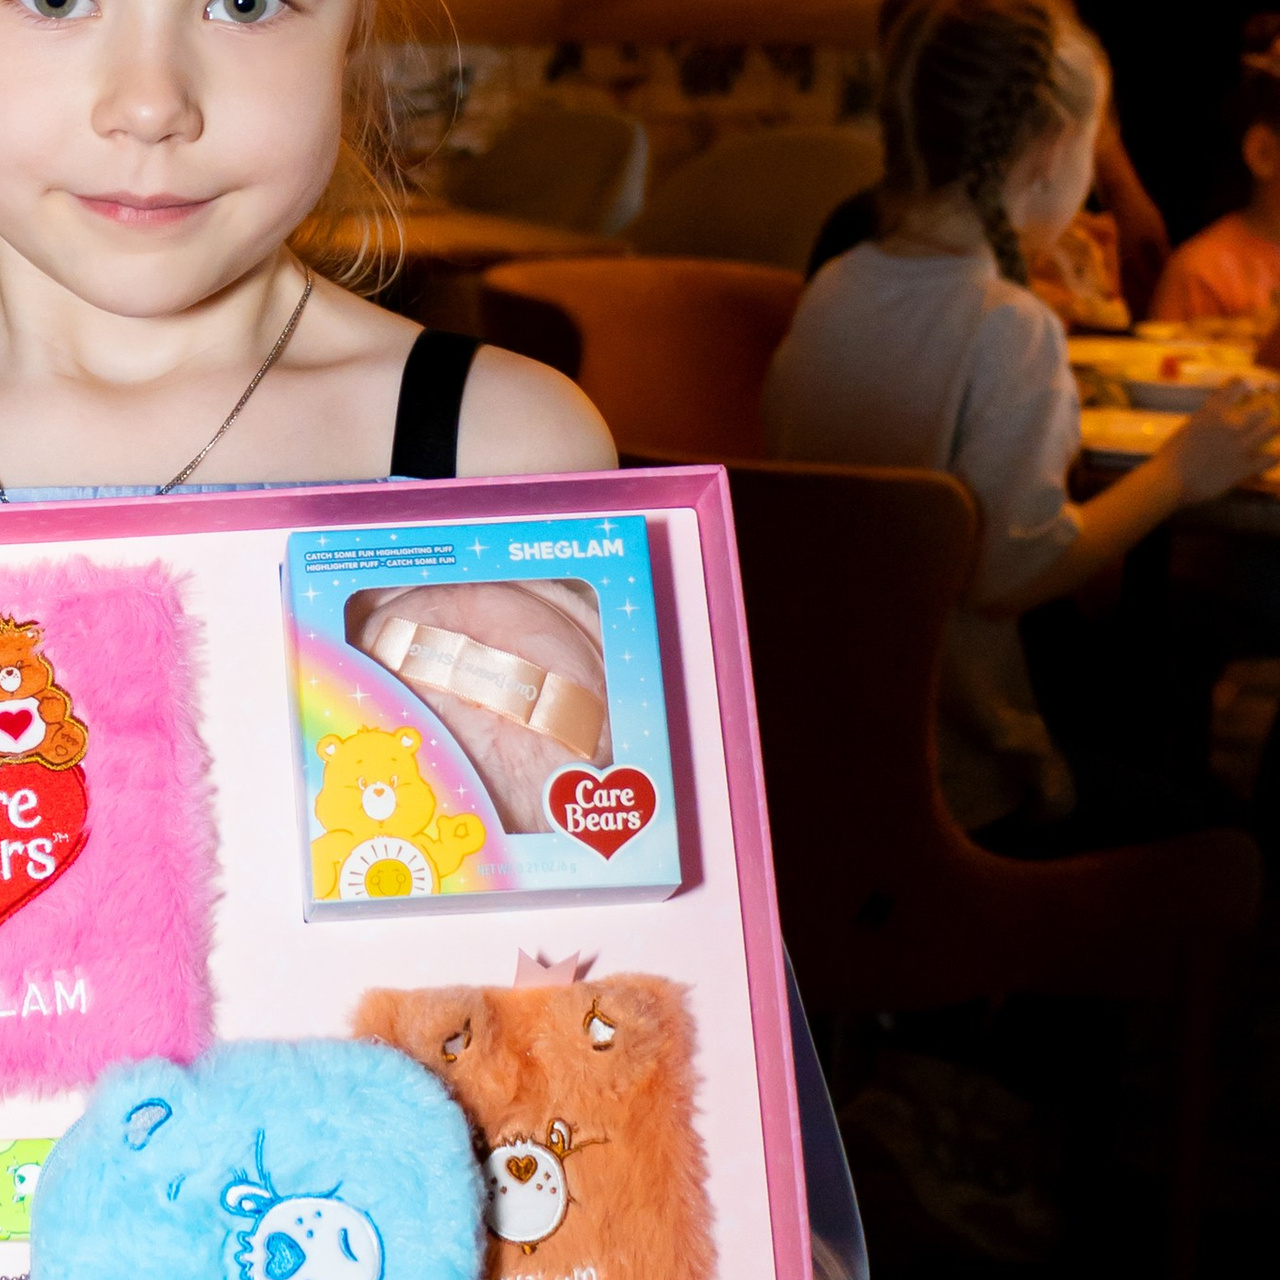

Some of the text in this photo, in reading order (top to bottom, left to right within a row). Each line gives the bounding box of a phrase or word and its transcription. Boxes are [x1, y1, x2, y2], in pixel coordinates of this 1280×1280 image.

[306, 545, 453, 561] CATCH SOME FUN HIGHLIGHTING PUFF
[508, 538, 624, 561] SHEGLAM
[306, 561, 358, 571] HIGHLIGHTER
[360, 560, 379, 569] PUFF
[386, 558, 413, 567] CATCH
[414, 557, 438, 566] SOME
[439, 556, 455, 564] FUN
[575, 779, 635, 809] Care
